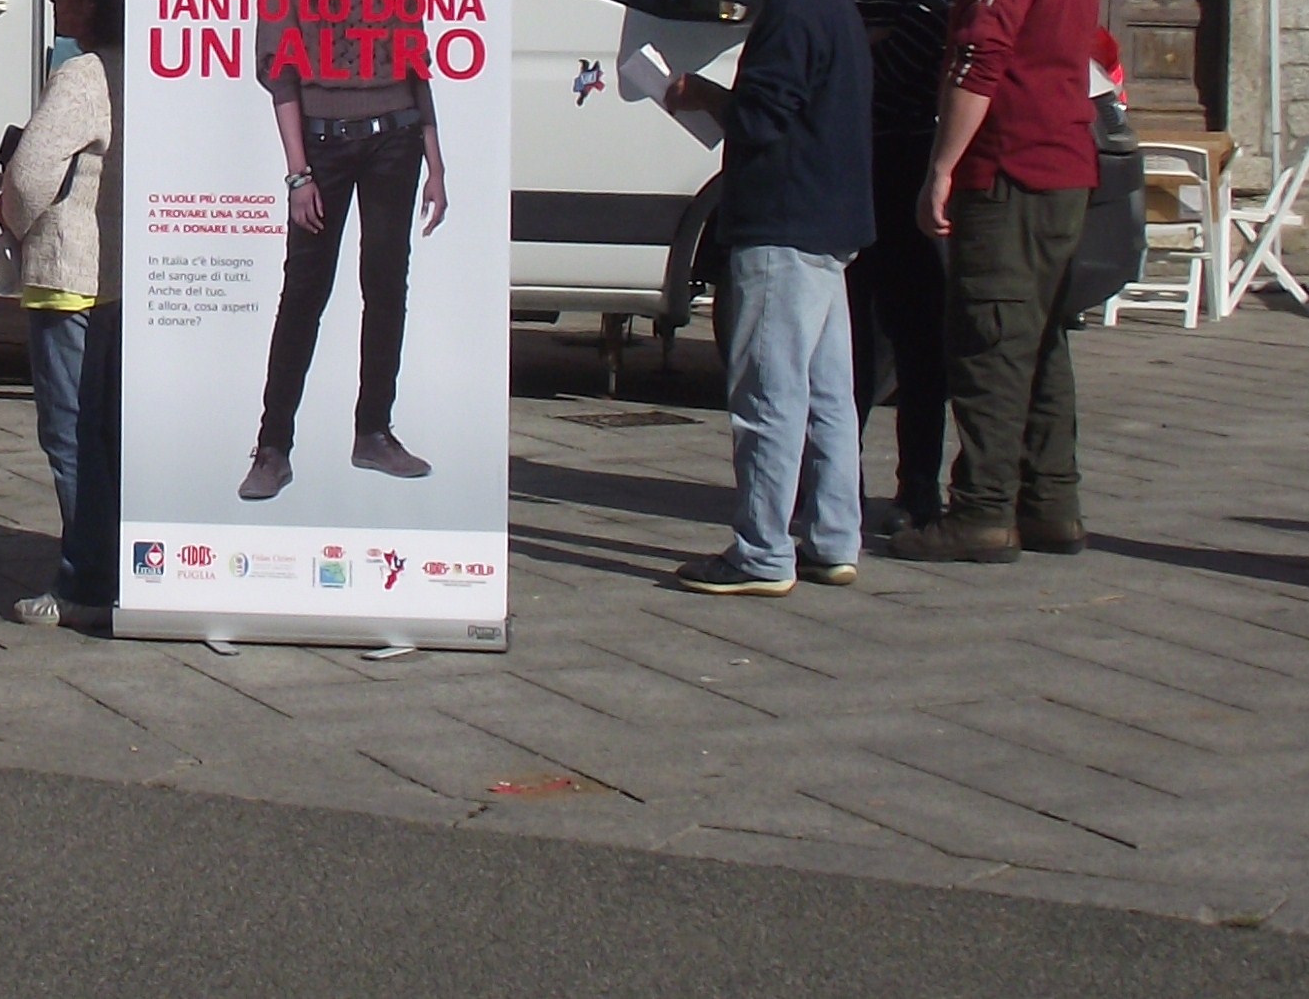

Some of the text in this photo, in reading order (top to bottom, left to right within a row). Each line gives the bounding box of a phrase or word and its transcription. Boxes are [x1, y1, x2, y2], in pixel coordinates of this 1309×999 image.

[150, 28, 486, 79] UN ALTRO
[149, 194, 159, 203] CI
[163, 194, 195, 203] VUOLE
[219, 194, 276, 204] CORAGGIO
[148, 209, 269, 219] A TROVARE UNA SCUSA
[148, 224, 169, 234] CHE
[173, 224, 180, 234] A
[183, 224, 228, 234] DONARE
[231, 224, 239, 234] IL
[149, 256, 158, 265] In
[162, 256, 188, 265] Italia
[210, 257, 254, 269] bisogno
[149, 272, 165, 281] del
[169, 273, 207, 283] sangue
[210, 272, 221, 281] di
[148, 286, 226, 296] Anche del tuo.
[148, 302, 154, 311] E
[222, 303, 259, 314] aspetti
[148, 316, 202, 326] a donare?
[182, 545, 212, 567] FIDAS
